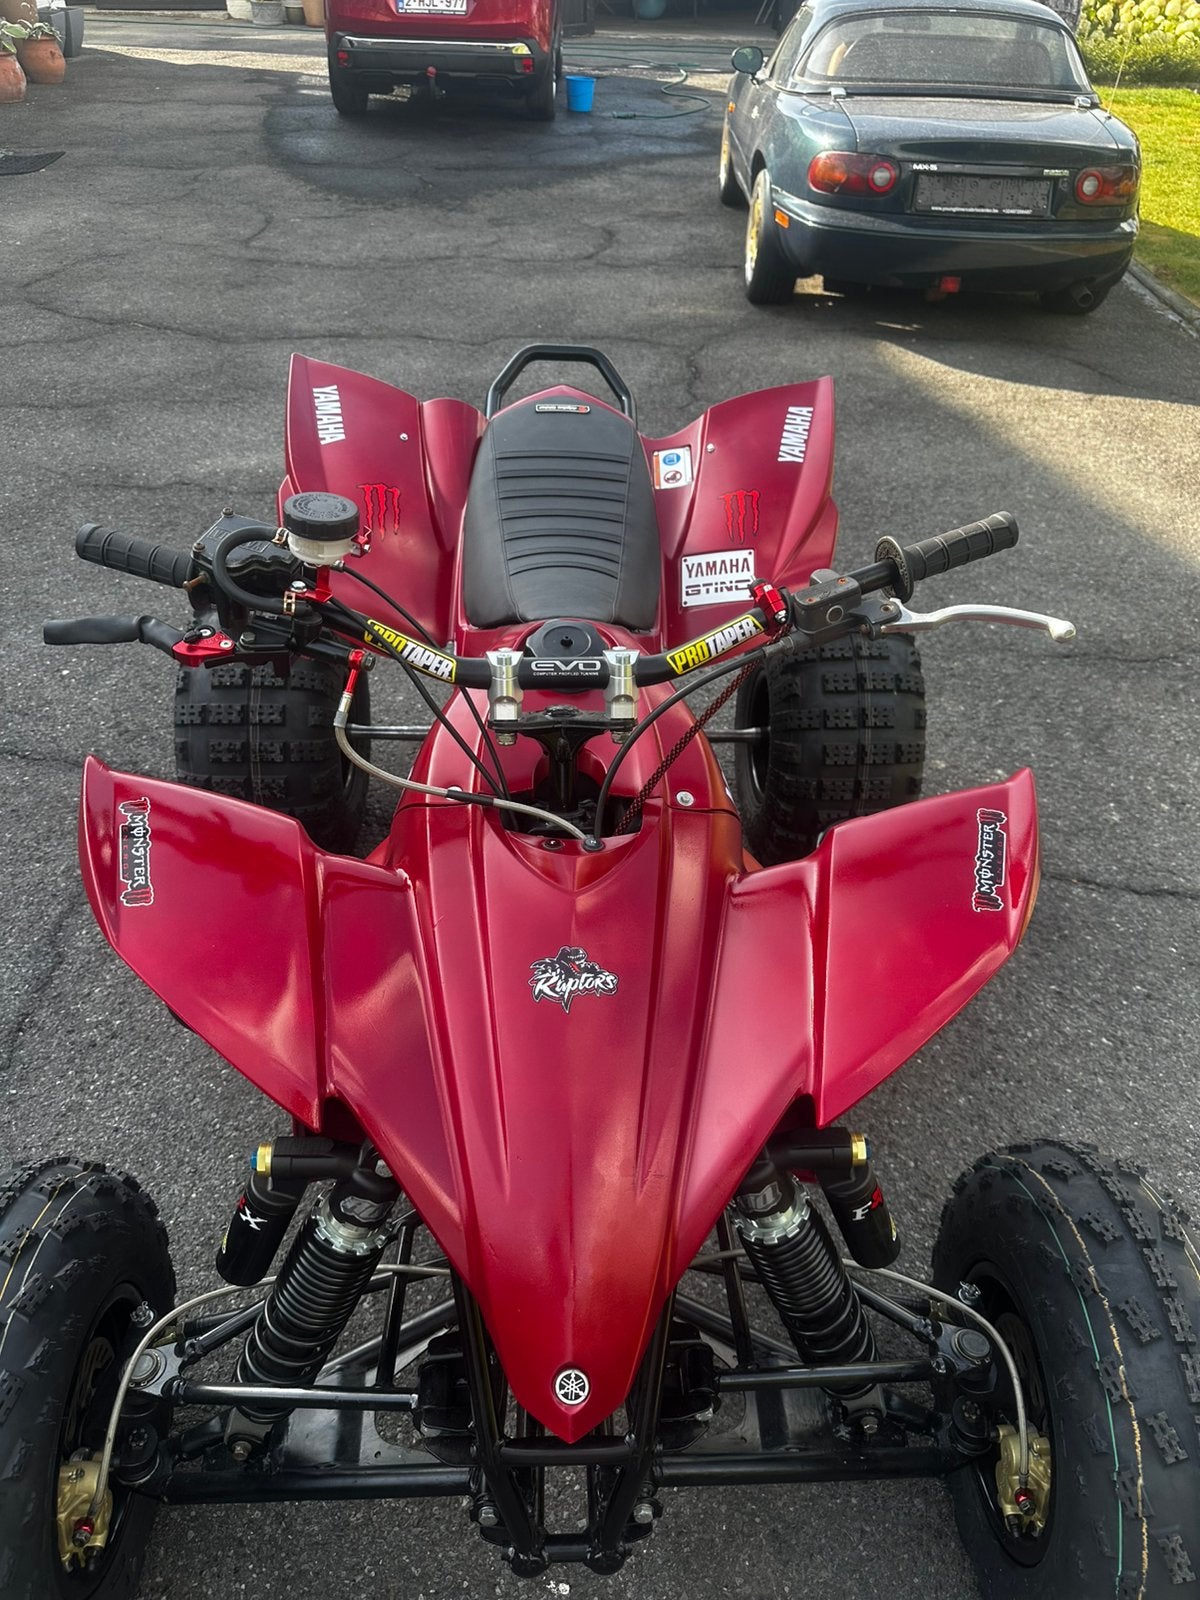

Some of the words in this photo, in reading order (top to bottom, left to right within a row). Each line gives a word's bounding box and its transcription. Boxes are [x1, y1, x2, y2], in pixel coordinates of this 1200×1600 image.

[912, 163, 938, 171] MX-5
[312, 384, 346, 446] YAMAHA
[777, 406, 814, 463] YAMAHA
[685, 557, 751, 579] YAMAHA
[530, 660, 602, 671] EVO
[674, 617, 757, 672] PROTAPER
[130, 814, 147, 888] MONSTER
[978, 823, 995, 892] MONSTER
